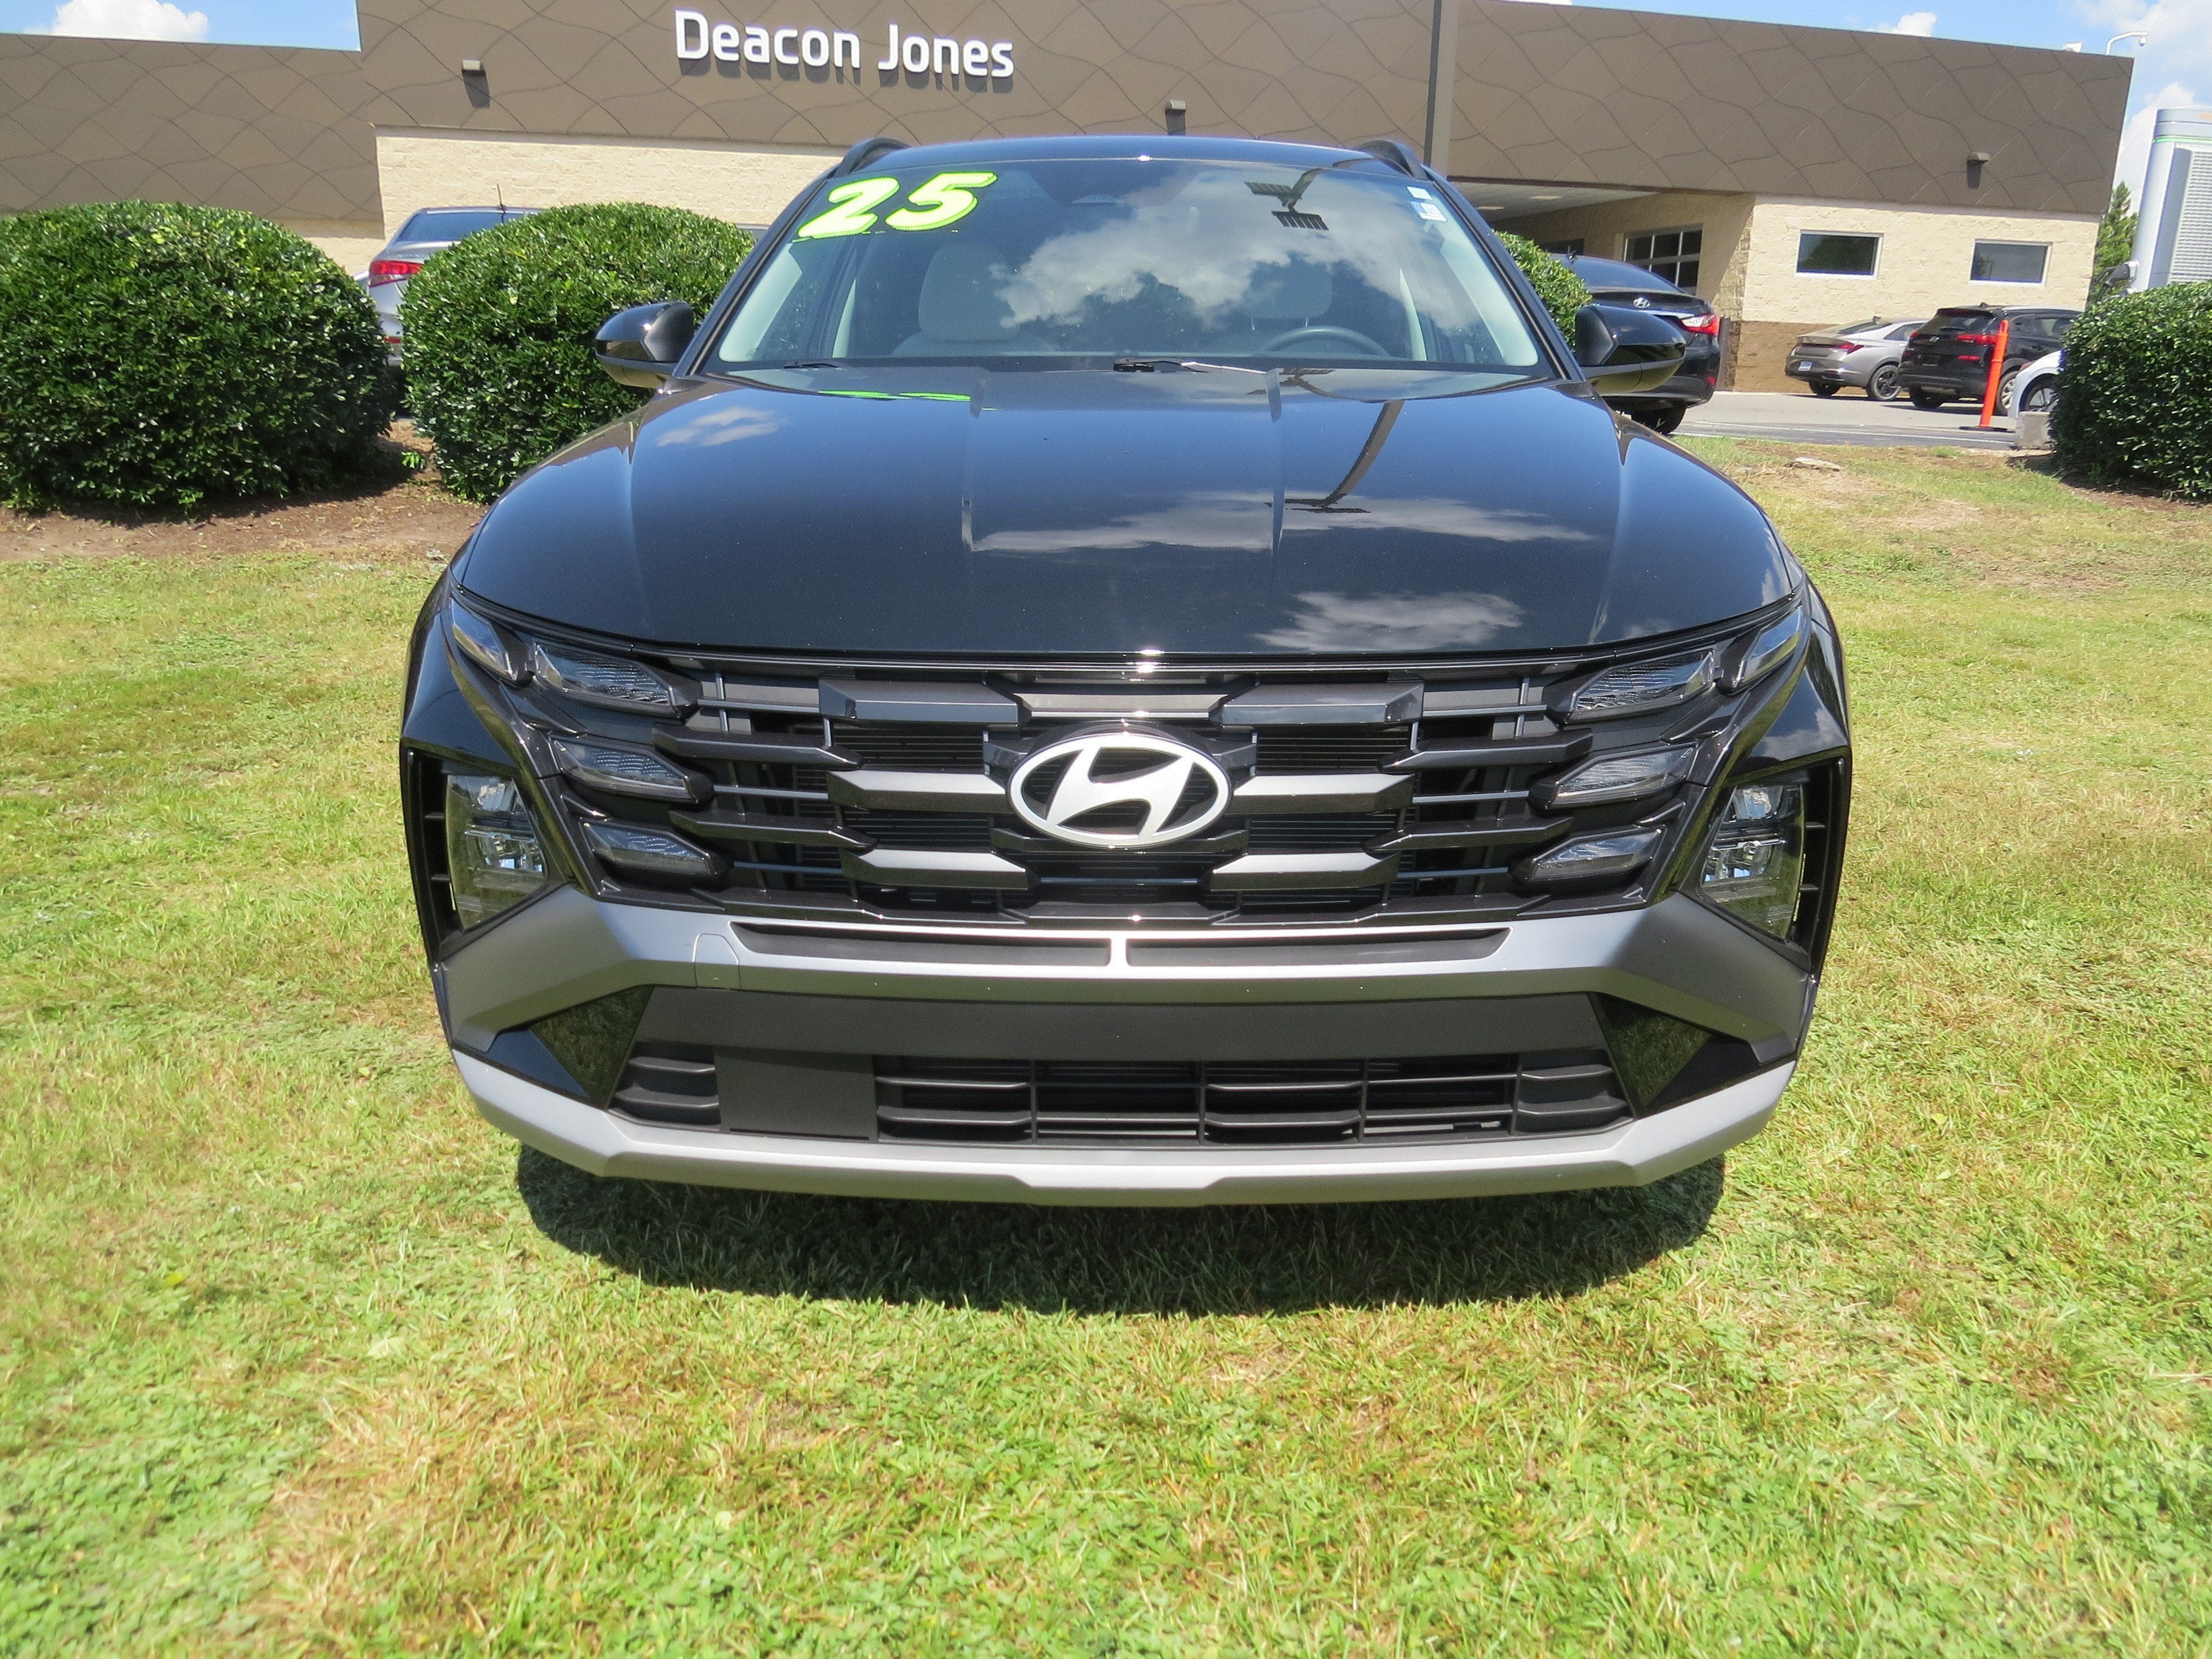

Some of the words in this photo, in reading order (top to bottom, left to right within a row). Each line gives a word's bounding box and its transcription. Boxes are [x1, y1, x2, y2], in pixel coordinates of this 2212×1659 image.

[674, 9, 860, 69] Deacon
[878, 23, 1014, 77] Jones
[798, 171, 998, 239] 25
